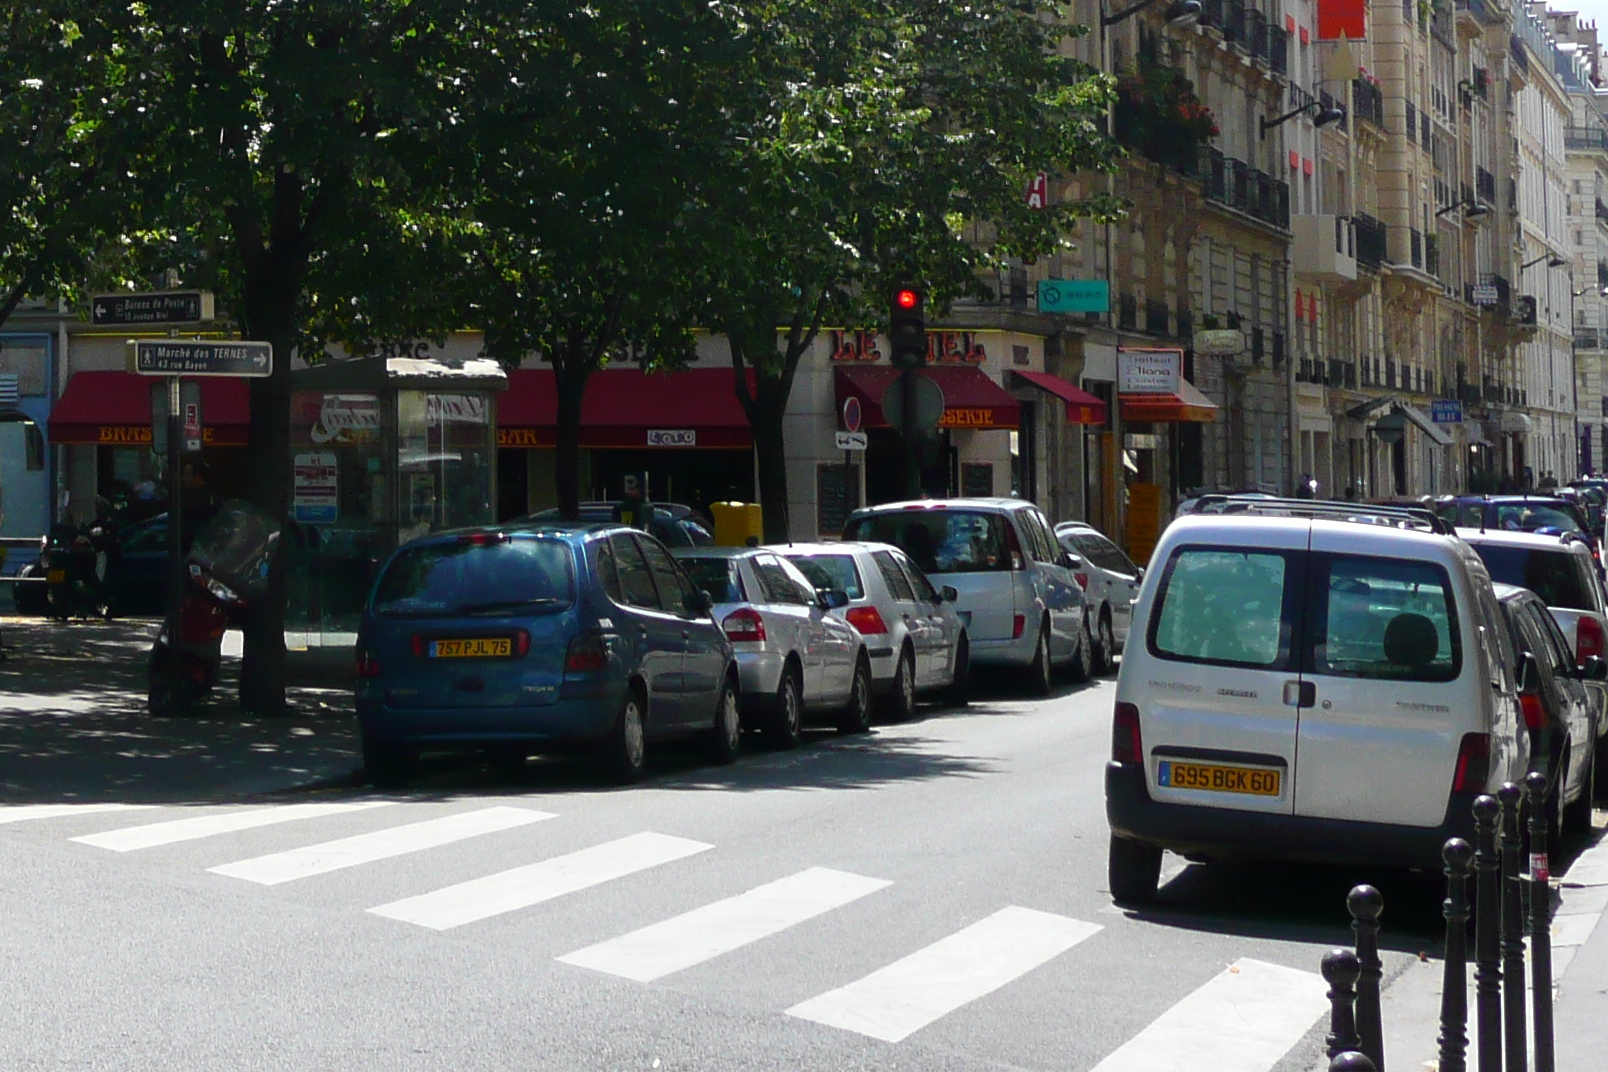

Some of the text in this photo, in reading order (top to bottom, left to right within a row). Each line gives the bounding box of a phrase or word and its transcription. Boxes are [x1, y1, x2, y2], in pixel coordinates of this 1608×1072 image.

[124, 297, 185, 310] Bureau de Poste
[157, 346, 248, 359] Marché des TERNES
[831, 330, 881, 361] LE
[925, 330, 987, 362] IEL
[98, 426, 214, 442] BRASE
[464, 641, 488, 655] PJL
[491, 640, 508, 654] 75
[1173, 766, 1275, 793] 695 BGK 60
